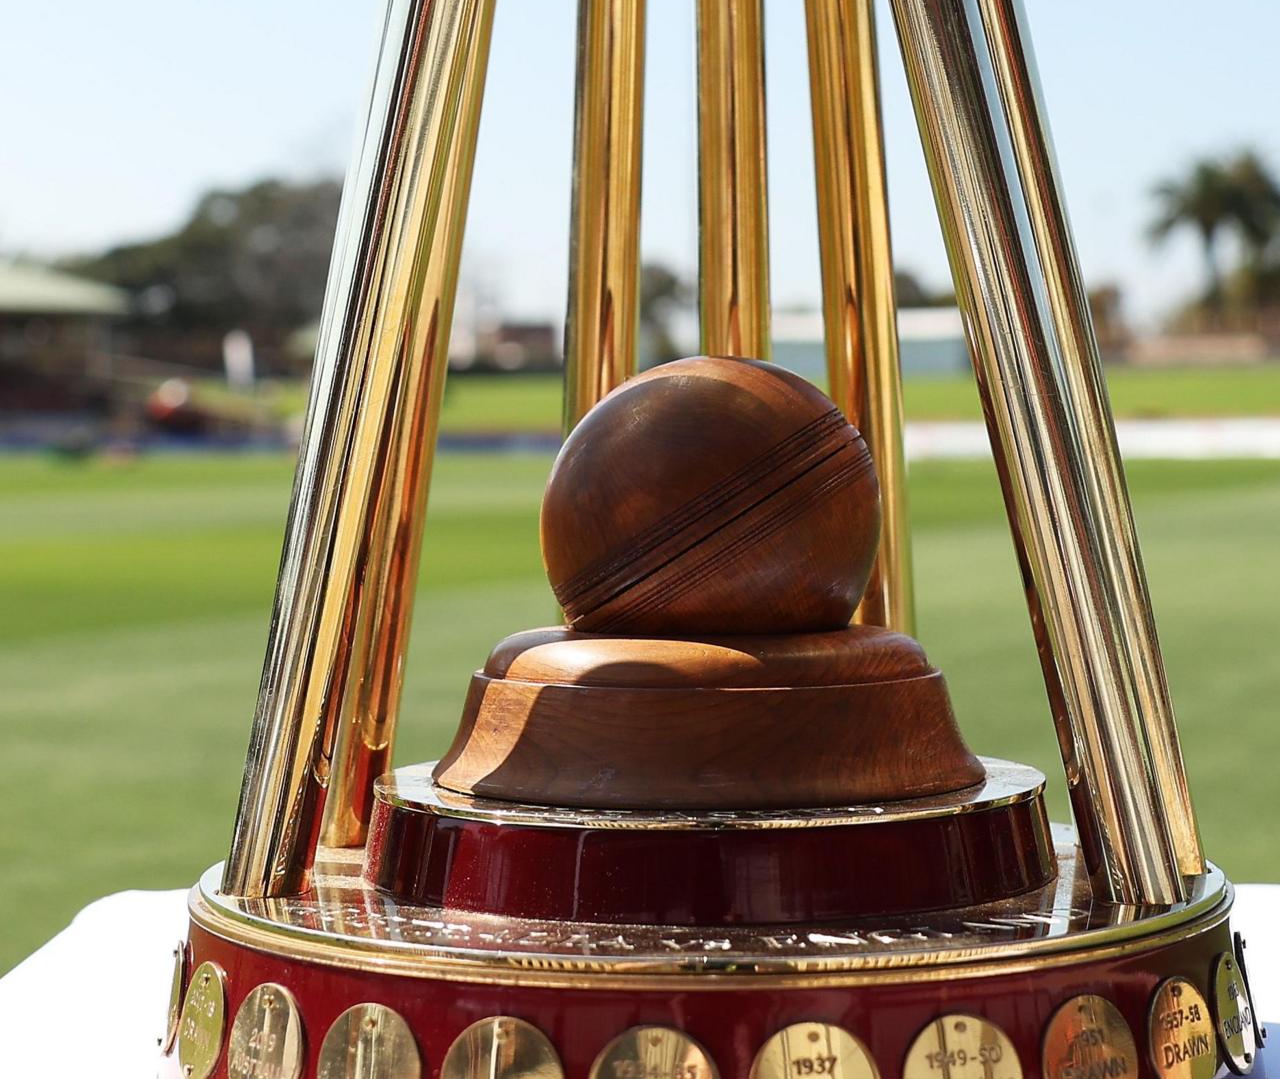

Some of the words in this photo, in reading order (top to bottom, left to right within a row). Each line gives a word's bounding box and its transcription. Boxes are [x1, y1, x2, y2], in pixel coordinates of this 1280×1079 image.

[925, 1043, 1003, 1070] 1949-50
[1163, 1032, 1211, 1069] DRAWN
[792, 1054, 838, 1076] 1937
